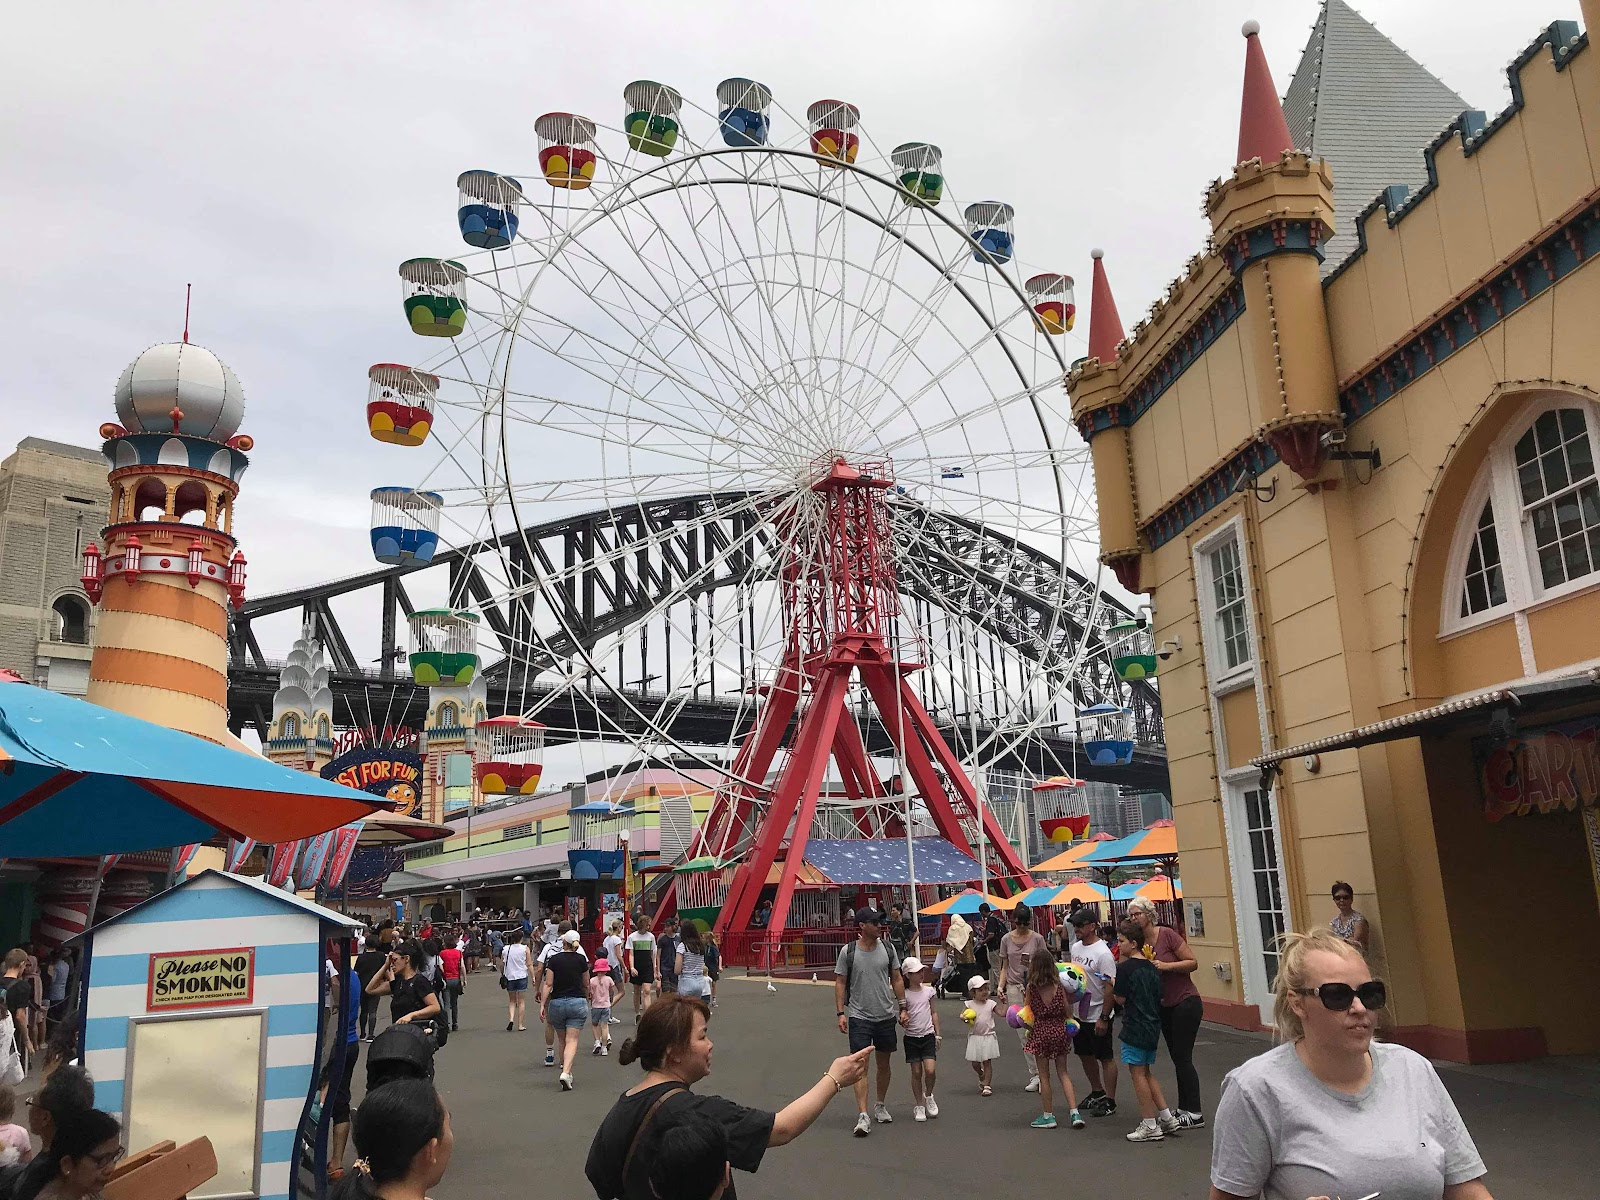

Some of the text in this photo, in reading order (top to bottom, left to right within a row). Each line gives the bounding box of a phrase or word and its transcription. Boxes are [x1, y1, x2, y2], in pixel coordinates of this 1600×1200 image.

[360, 761, 391, 785] FOR
[392, 761, 419, 782] FUN
[1485, 726, 1600, 811] CART
[157, 956, 247, 979] Please NO
[155, 974, 246, 995] SMOKING
